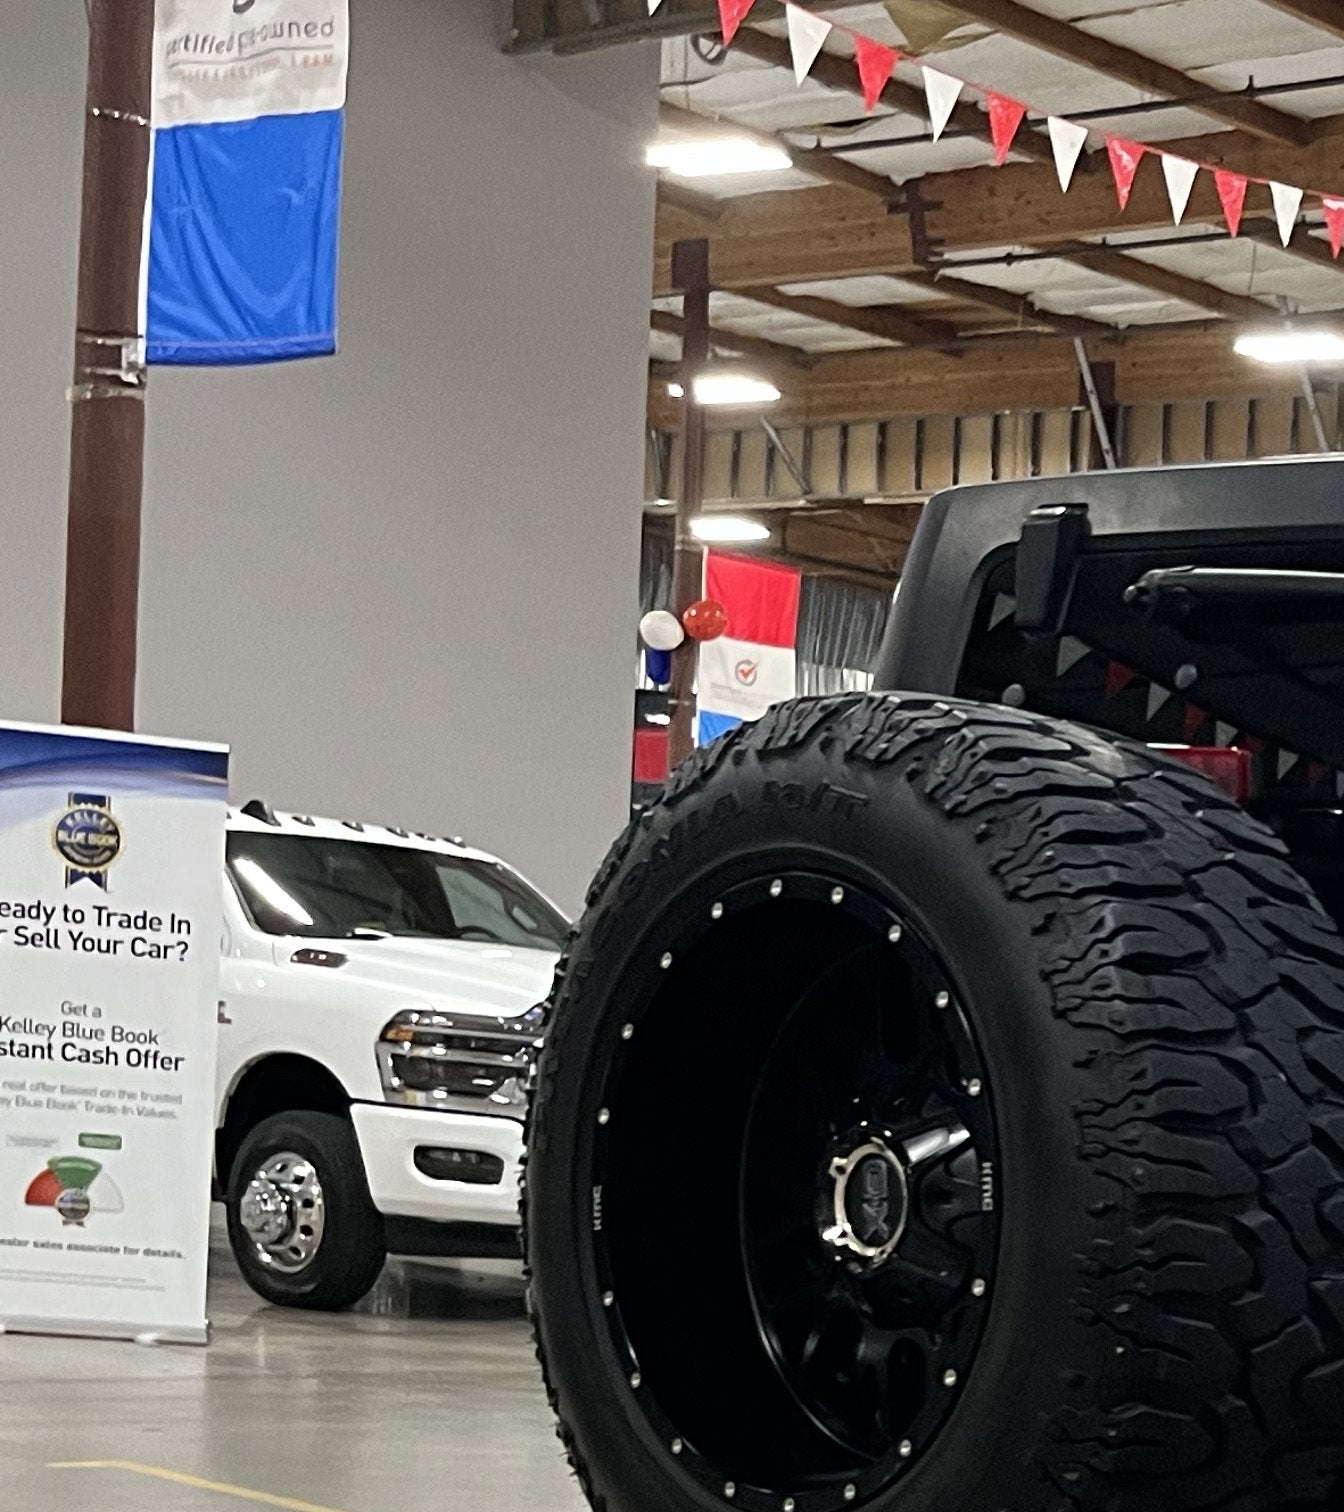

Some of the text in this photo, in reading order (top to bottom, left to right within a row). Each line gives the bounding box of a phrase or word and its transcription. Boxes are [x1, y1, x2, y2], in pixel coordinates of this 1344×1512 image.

[0, 900, 191, 935] eady to Trade In
[14, 926, 189, 962] Sell Your Car?
[61, 1000, 102, 1018] Get a
[0, 1015, 159, 1045] Kelley Blue Book
[0, 1039, 185, 1072] stant Cash Offer
